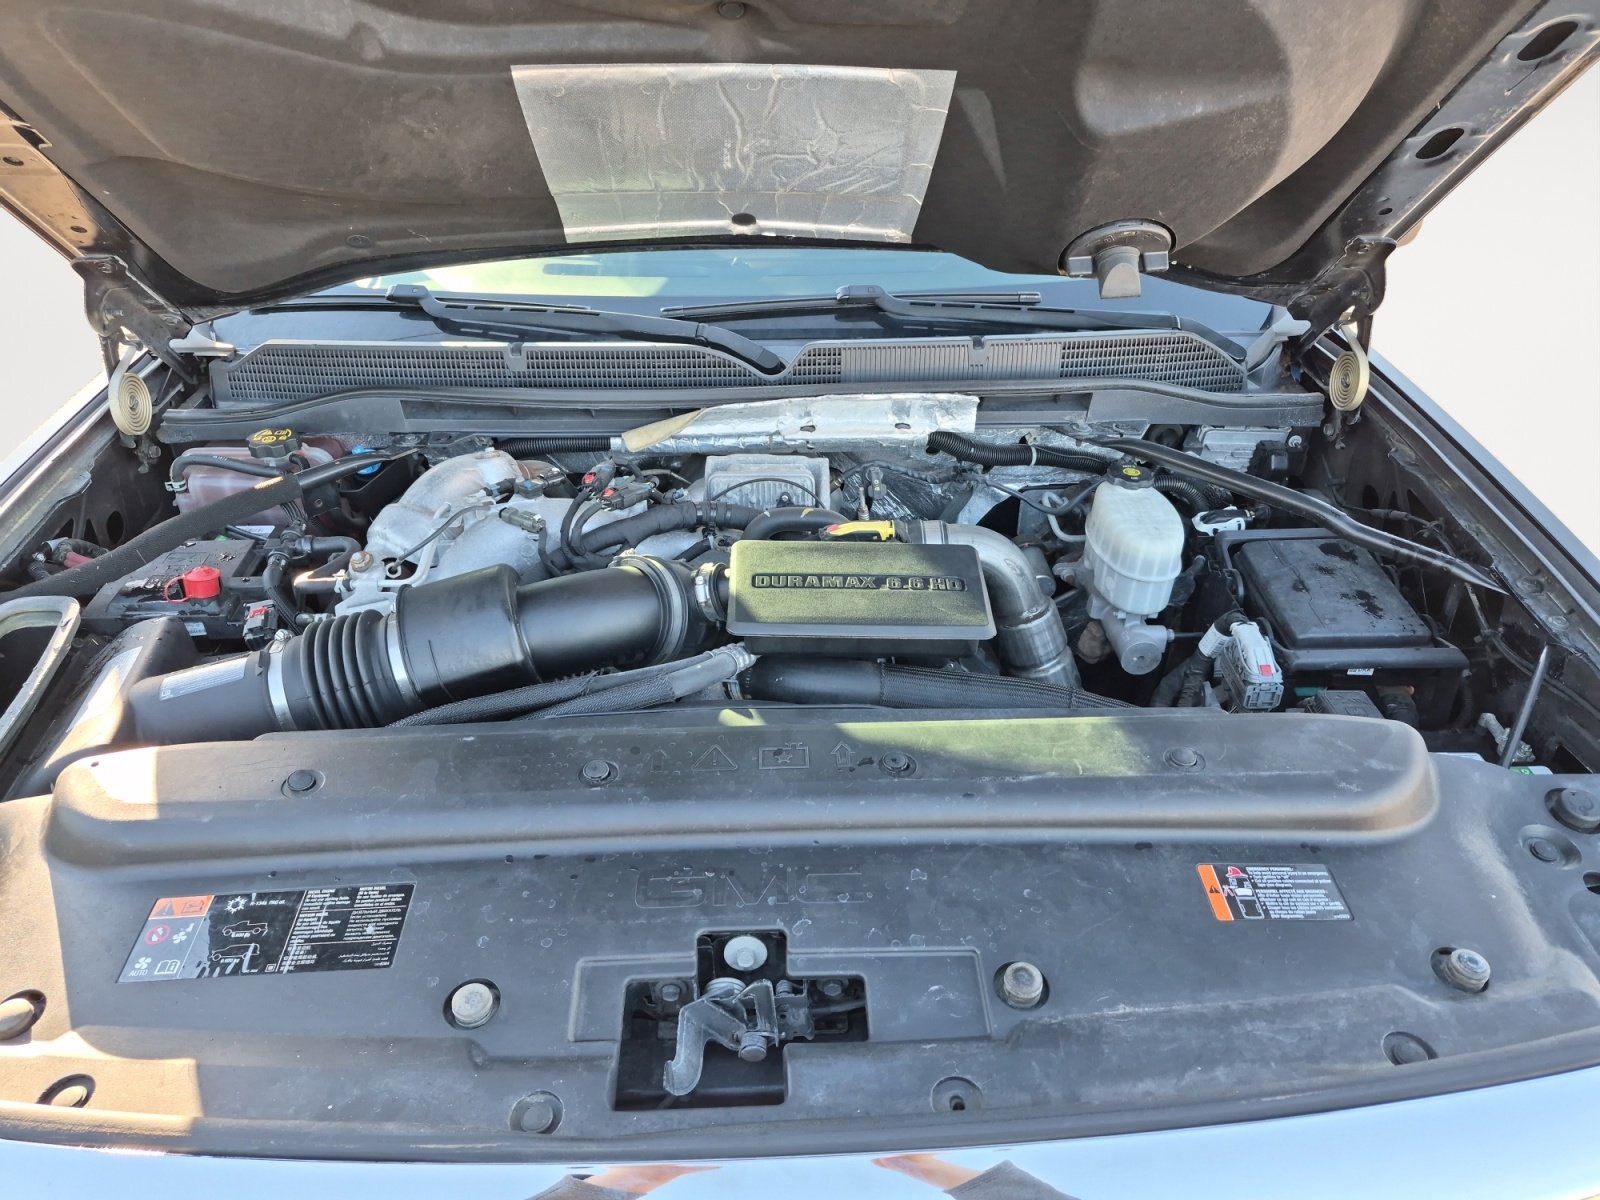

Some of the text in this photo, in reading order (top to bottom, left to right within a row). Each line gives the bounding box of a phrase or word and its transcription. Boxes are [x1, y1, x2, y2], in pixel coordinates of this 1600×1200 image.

[753, 574, 966, 592] DURAMAX 6.6 HD
[633, 868, 866, 909] GMC
[128, 969, 149, 977] AUTO
